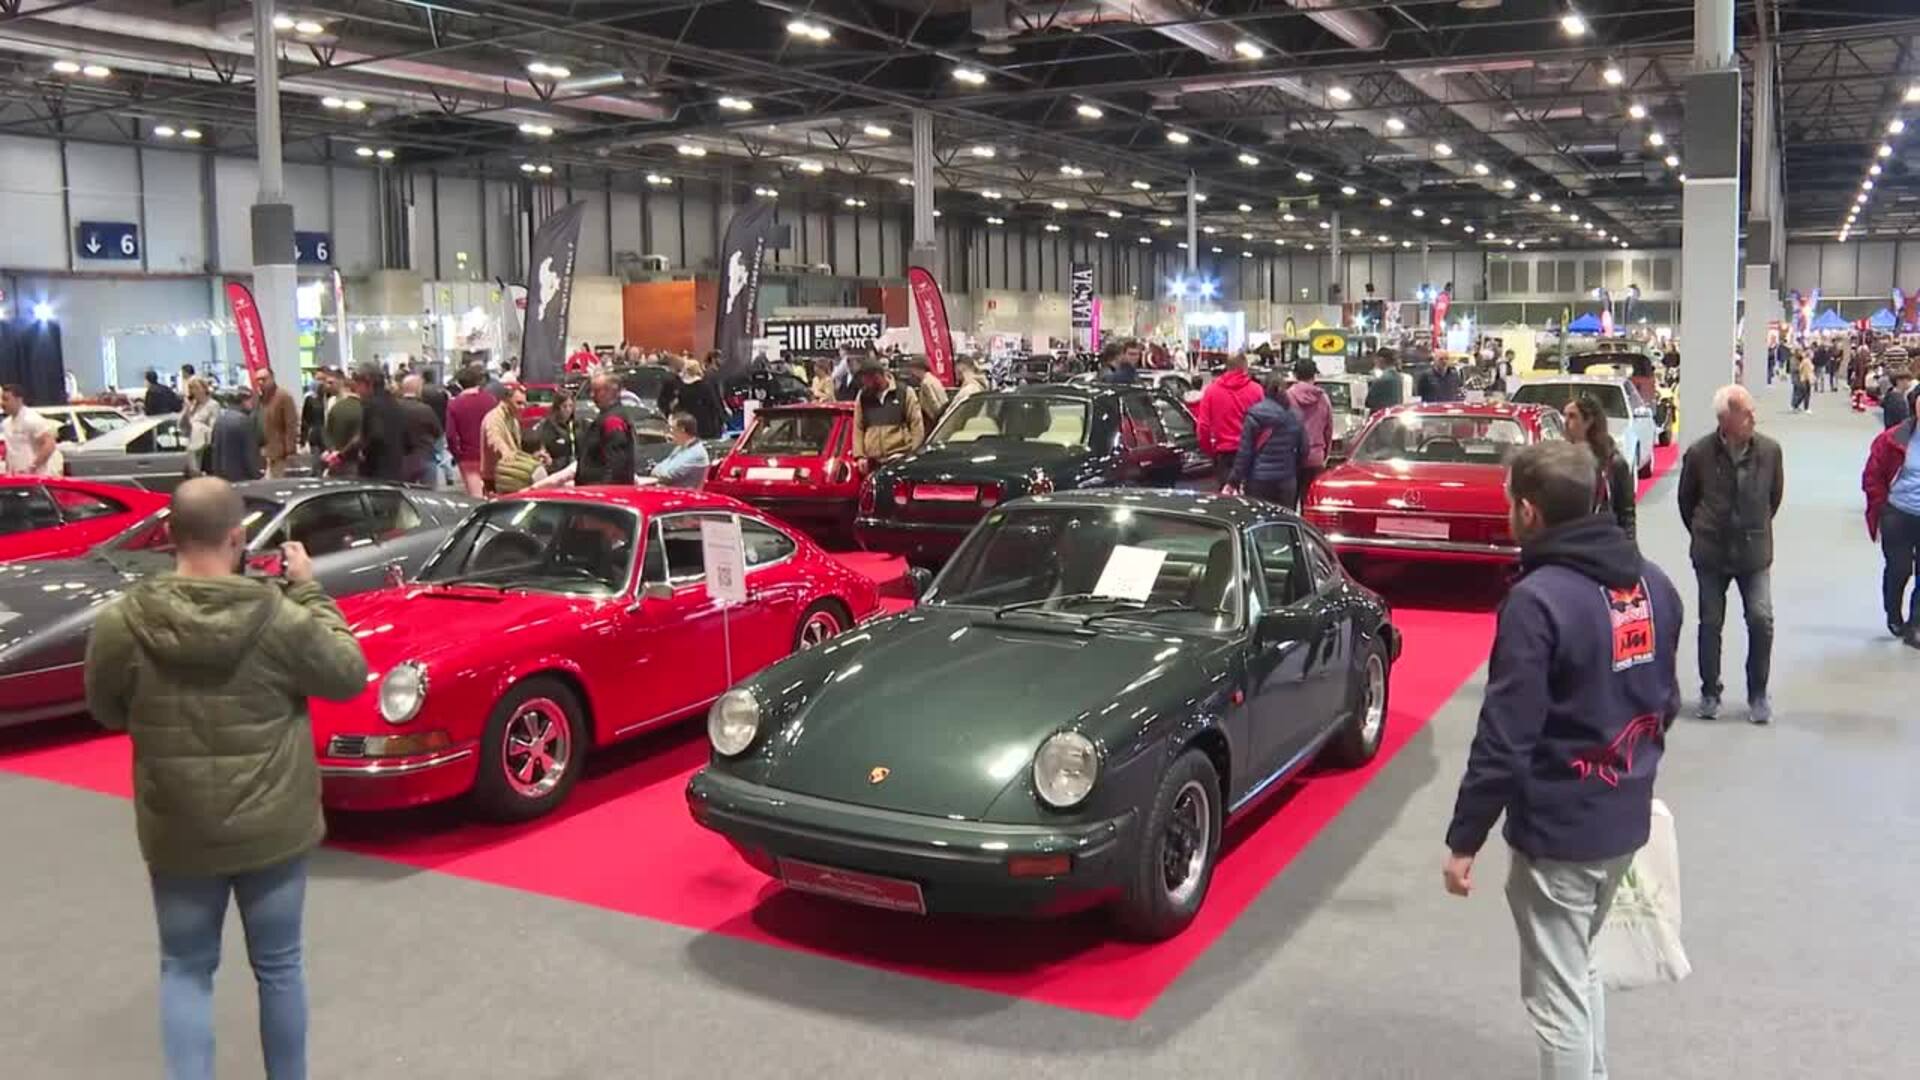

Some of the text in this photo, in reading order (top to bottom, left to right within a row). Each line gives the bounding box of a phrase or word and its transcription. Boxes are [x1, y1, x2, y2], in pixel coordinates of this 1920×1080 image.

[120, 234, 135, 255] 6
[316, 242, 328, 261] 6
[1073, 268, 1093, 322] LANCIA
[815, 323, 879, 338] EVENTOS
